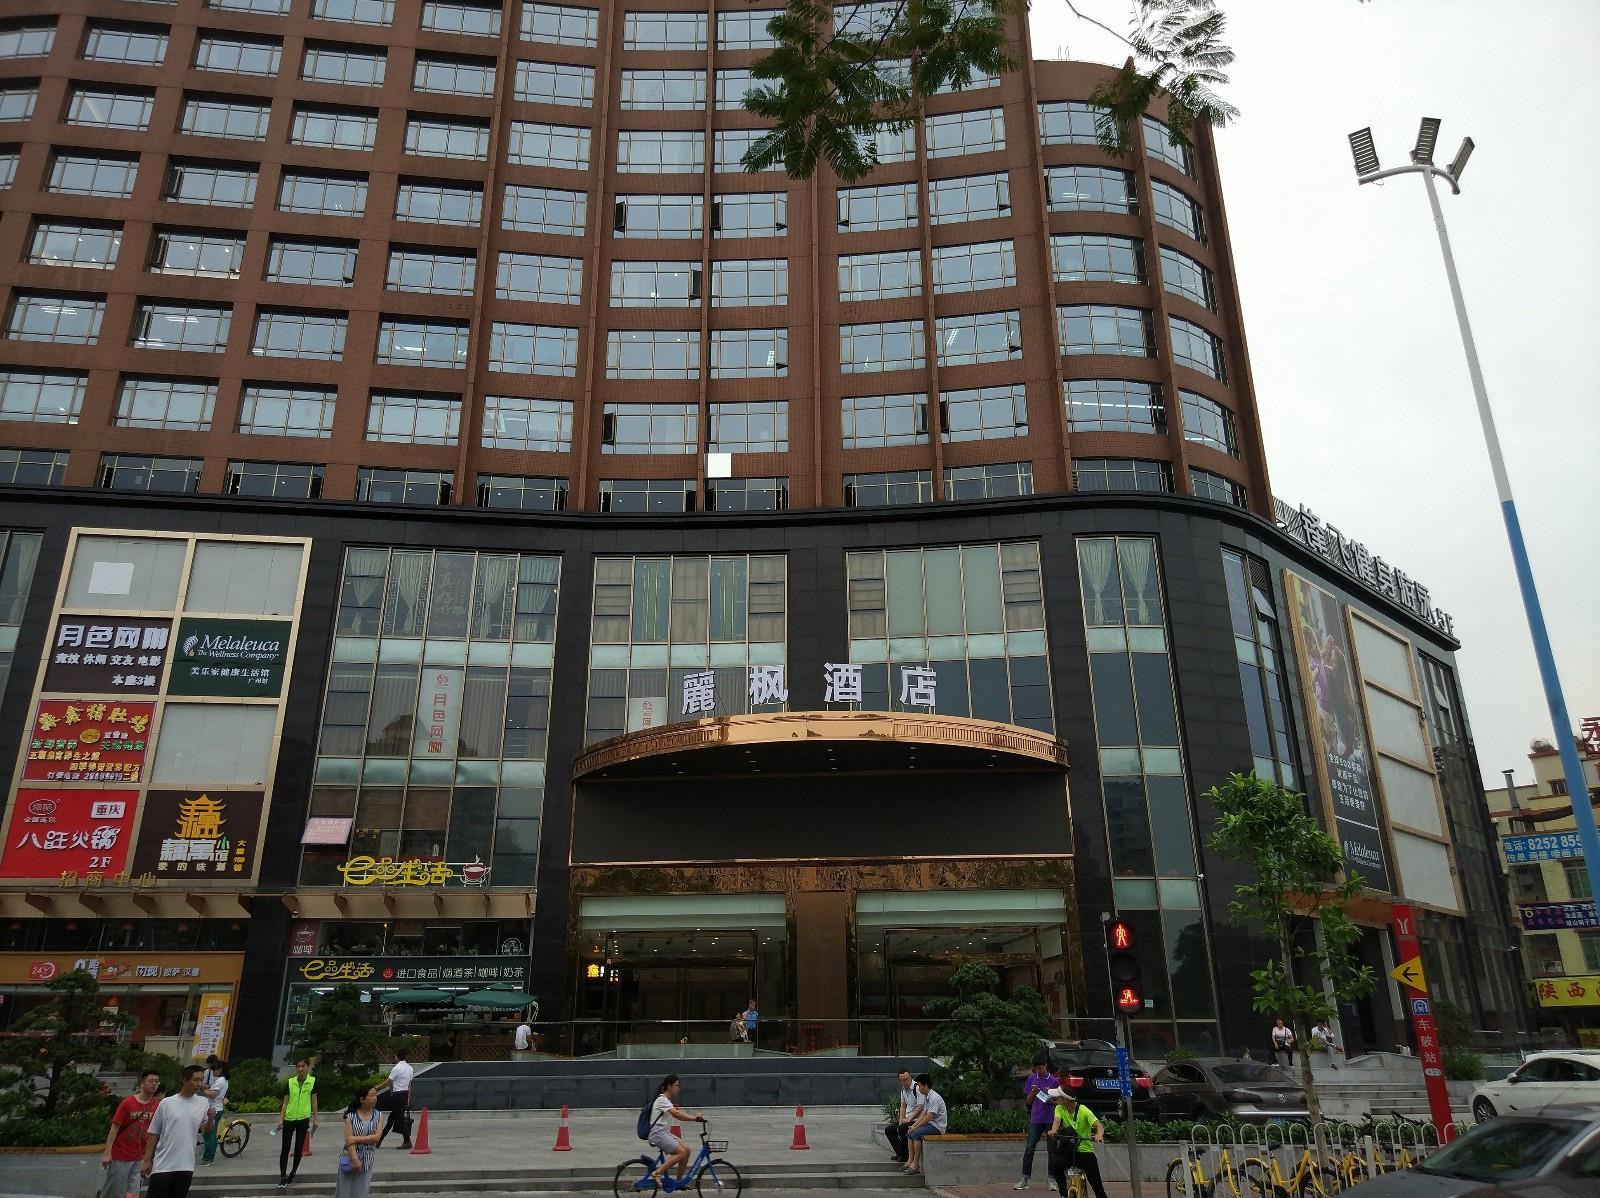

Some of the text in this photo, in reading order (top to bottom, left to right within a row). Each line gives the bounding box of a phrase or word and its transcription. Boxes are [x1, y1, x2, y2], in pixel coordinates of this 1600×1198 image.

[200, 634, 280, 652] Melaleuca
[209, 650, 239, 658] Wellness
[240, 651, 276, 661] Company
[681, 662, 937, 715] 麗枫酒店
[95, 804, 121, 816] 重庆
[1527, 836, 1558, 850] 8252
[89, 856, 112, 868] 2F
[59, 870, 157, 887] 招商中心
[1538, 981, 1600, 1000] 陕西
